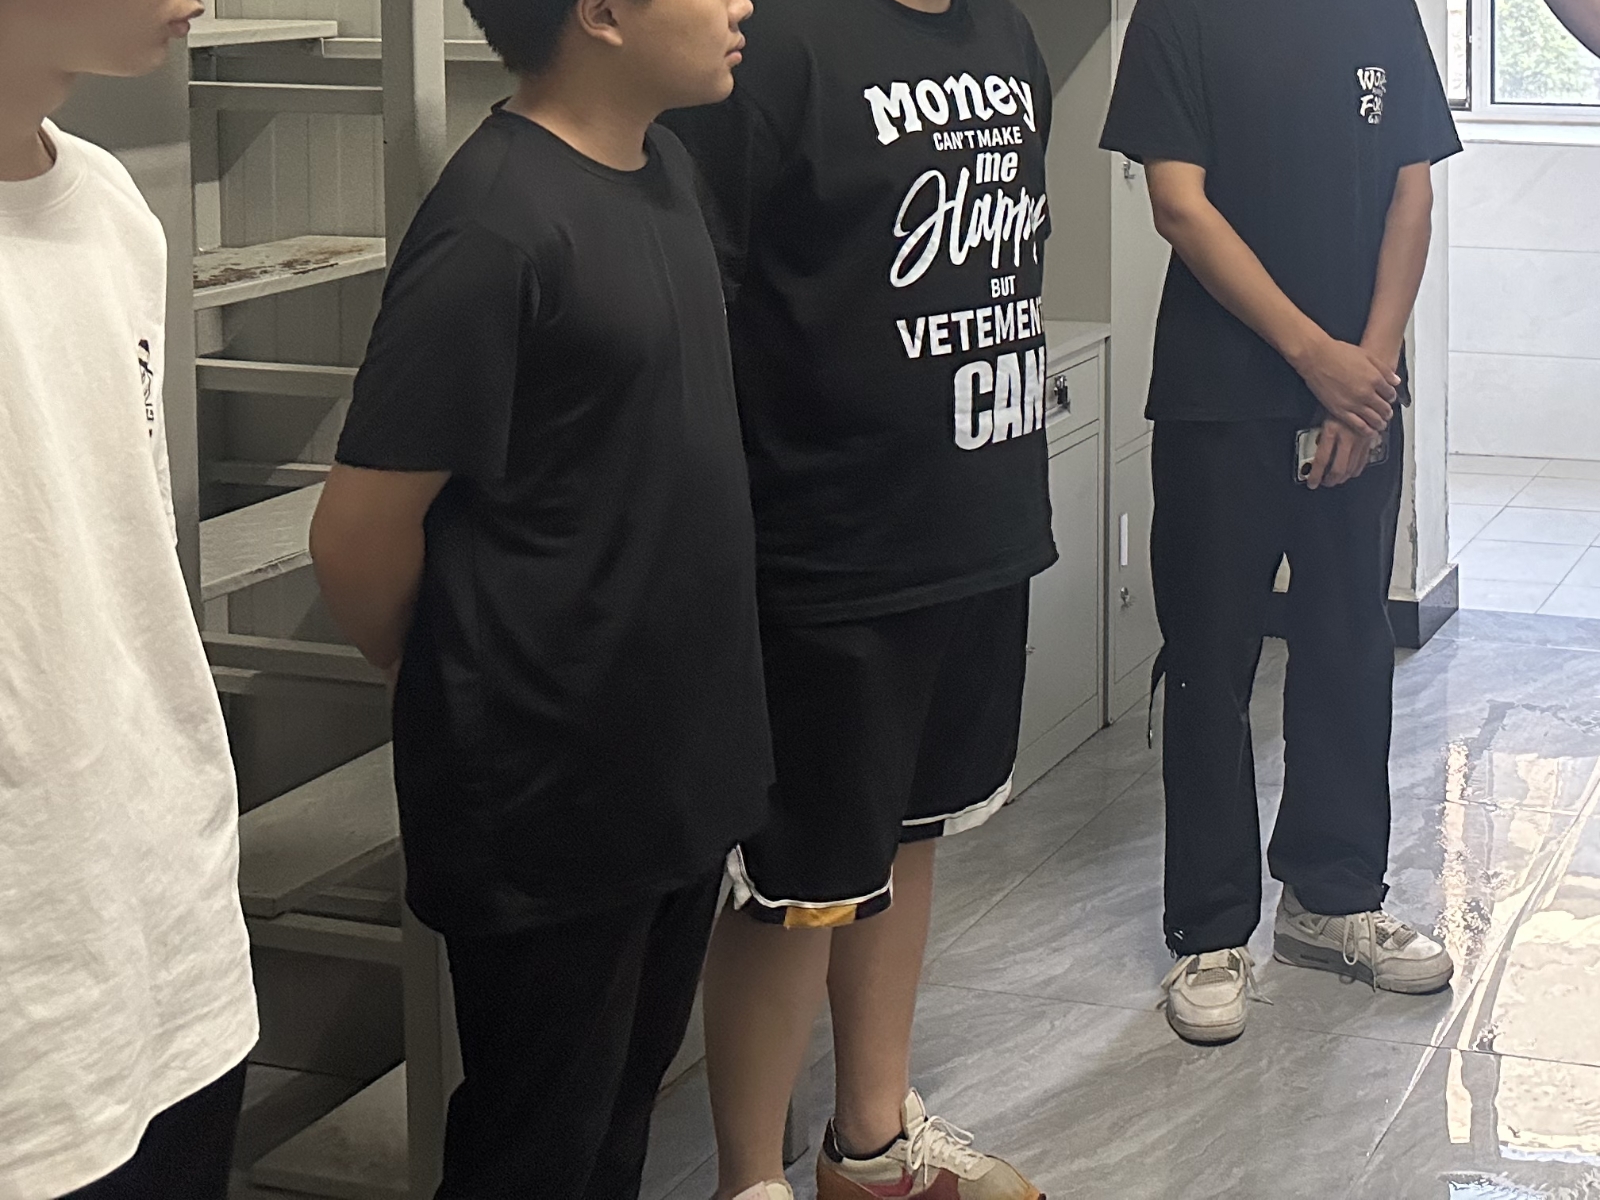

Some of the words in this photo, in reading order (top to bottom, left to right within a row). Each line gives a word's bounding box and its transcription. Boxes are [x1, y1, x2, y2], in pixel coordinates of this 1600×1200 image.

[863, 71, 1037, 146] Money
[932, 130, 975, 151] CAN'T
[976, 125, 1023, 148] MAKE
[975, 151, 1019, 185] me
[990, 275, 1016, 299] BUT
[953, 345, 1045, 451] CAN
